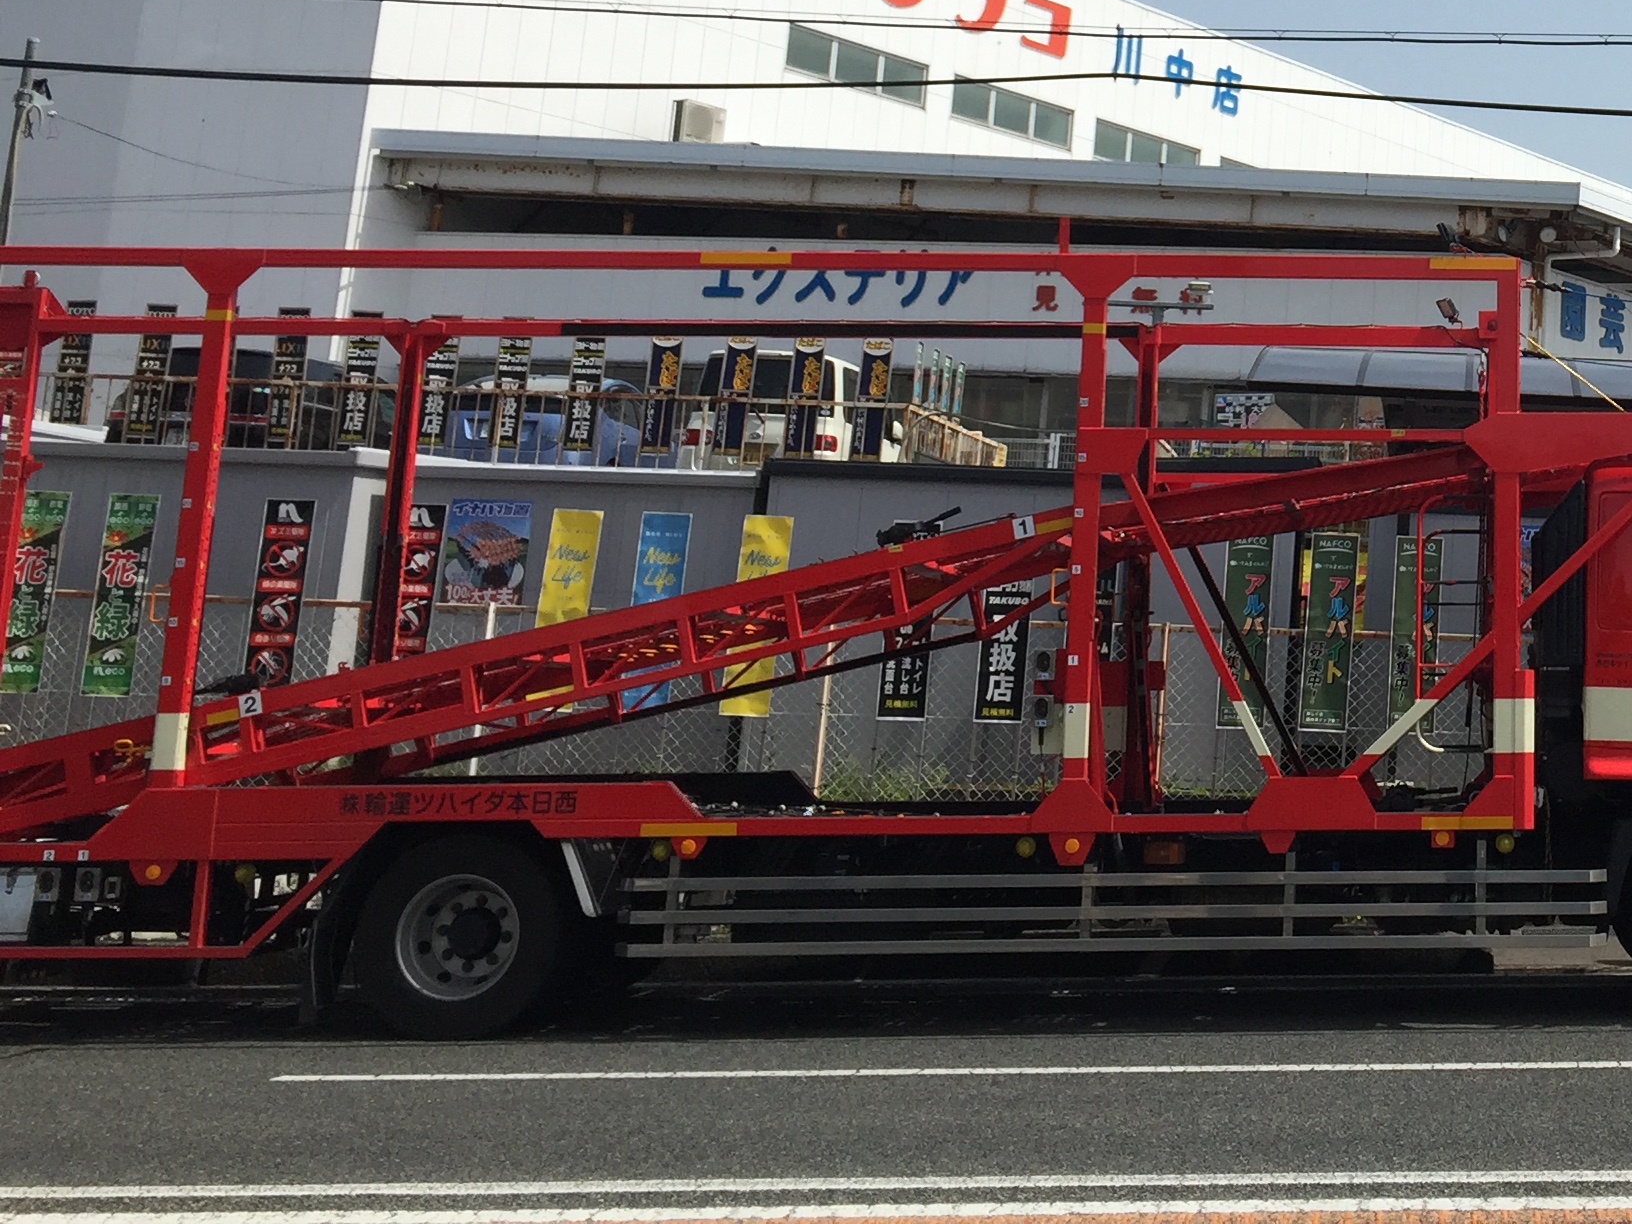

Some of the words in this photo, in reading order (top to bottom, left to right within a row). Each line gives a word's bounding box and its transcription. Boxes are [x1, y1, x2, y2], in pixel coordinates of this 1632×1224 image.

[1112, 24, 1242, 117] 川中店
[1018, 519, 1028, 536] 1
[1319, 539, 1352, 549] NAFCO
[552, 545, 590, 563] New
[643, 547, 681, 565] New
[744, 549, 781, 567] New
[551, 566, 583, 589] Life
[643, 567, 676, 594] Life
[92, 550, 139, 641] 花と緑
[988, 597, 1030, 605] TAKUBO
[1326, 576, 1350, 684] アルバイト
[912, 657, 924, 694] トイレ
[244, 696, 258, 714] 2
